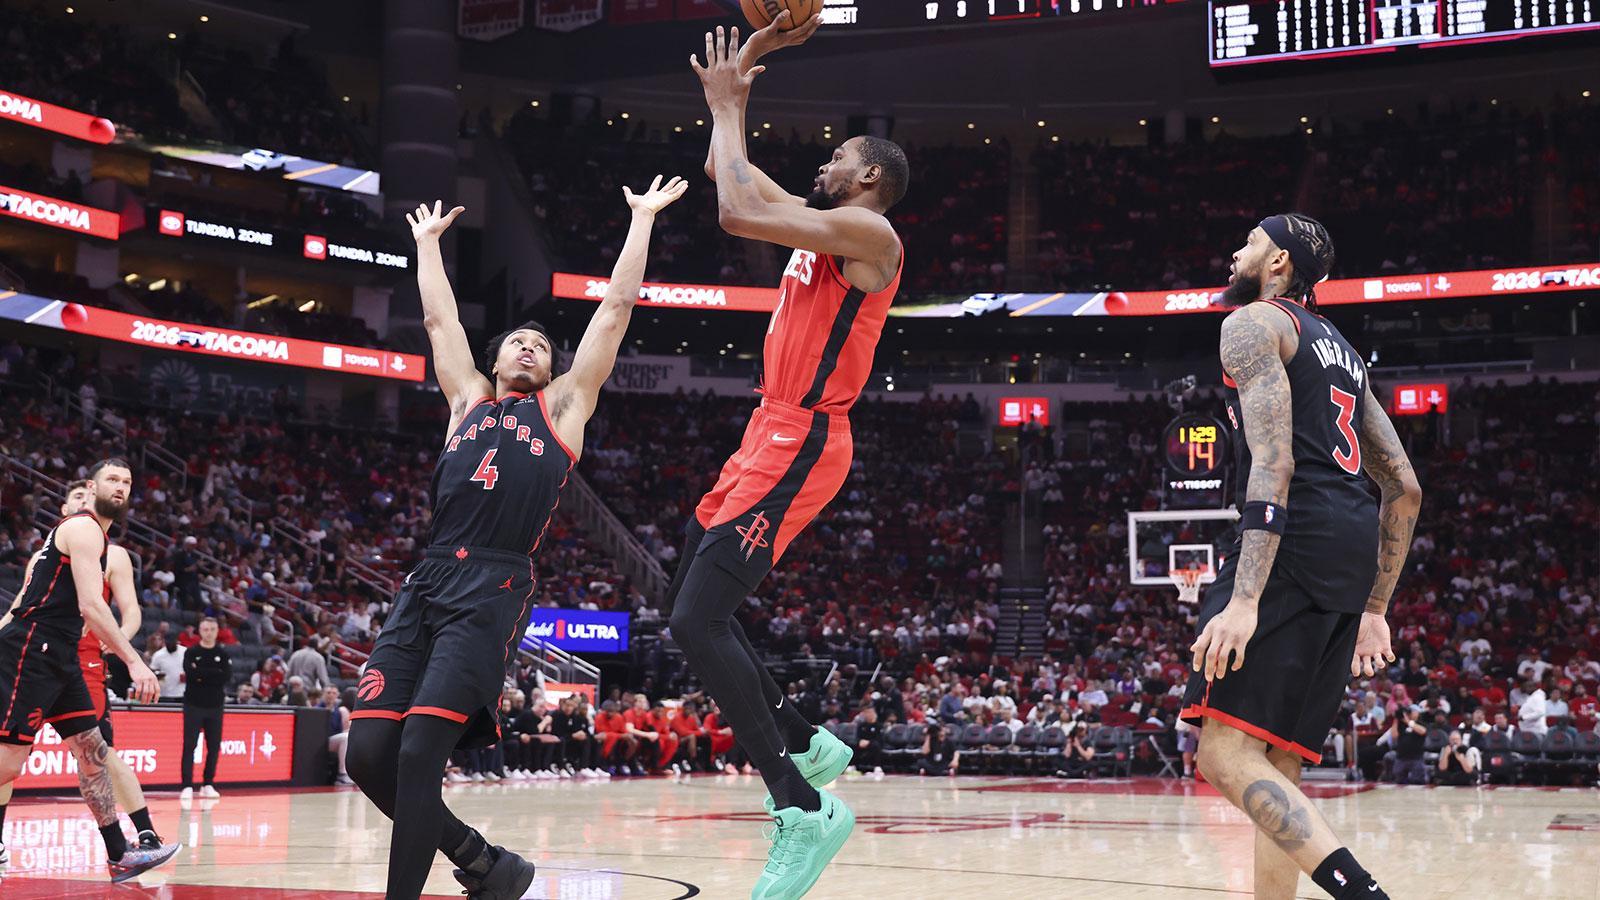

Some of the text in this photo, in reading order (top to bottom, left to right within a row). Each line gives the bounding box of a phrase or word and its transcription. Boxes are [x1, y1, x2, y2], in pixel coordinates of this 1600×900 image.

[9, 194, 90, 229] TACOMA
[185, 219, 273, 246] TUNDRA ZONE
[328, 243, 408, 268] TUNDRA ZONE
[585, 280, 727, 305] 20 TACOMA
[1386, 282, 1423, 294] TOYOTA
[1491, 271, 1541, 291] 2026
[1164, 291, 1209, 311] 2026
[131, 320, 288, 360] 2026 TACOMA
[344, 353, 380, 368] TOYOTA
[1311, 338, 1363, 389] INGRAM
[447, 415, 545, 456] RAPORS
[1330, 384, 1361, 475] 3
[470, 448, 499, 490] 4
[1188, 442, 1214, 471] 14
[567, 623, 619, 640] ULTRA
[220, 740, 247, 755] YOTA
